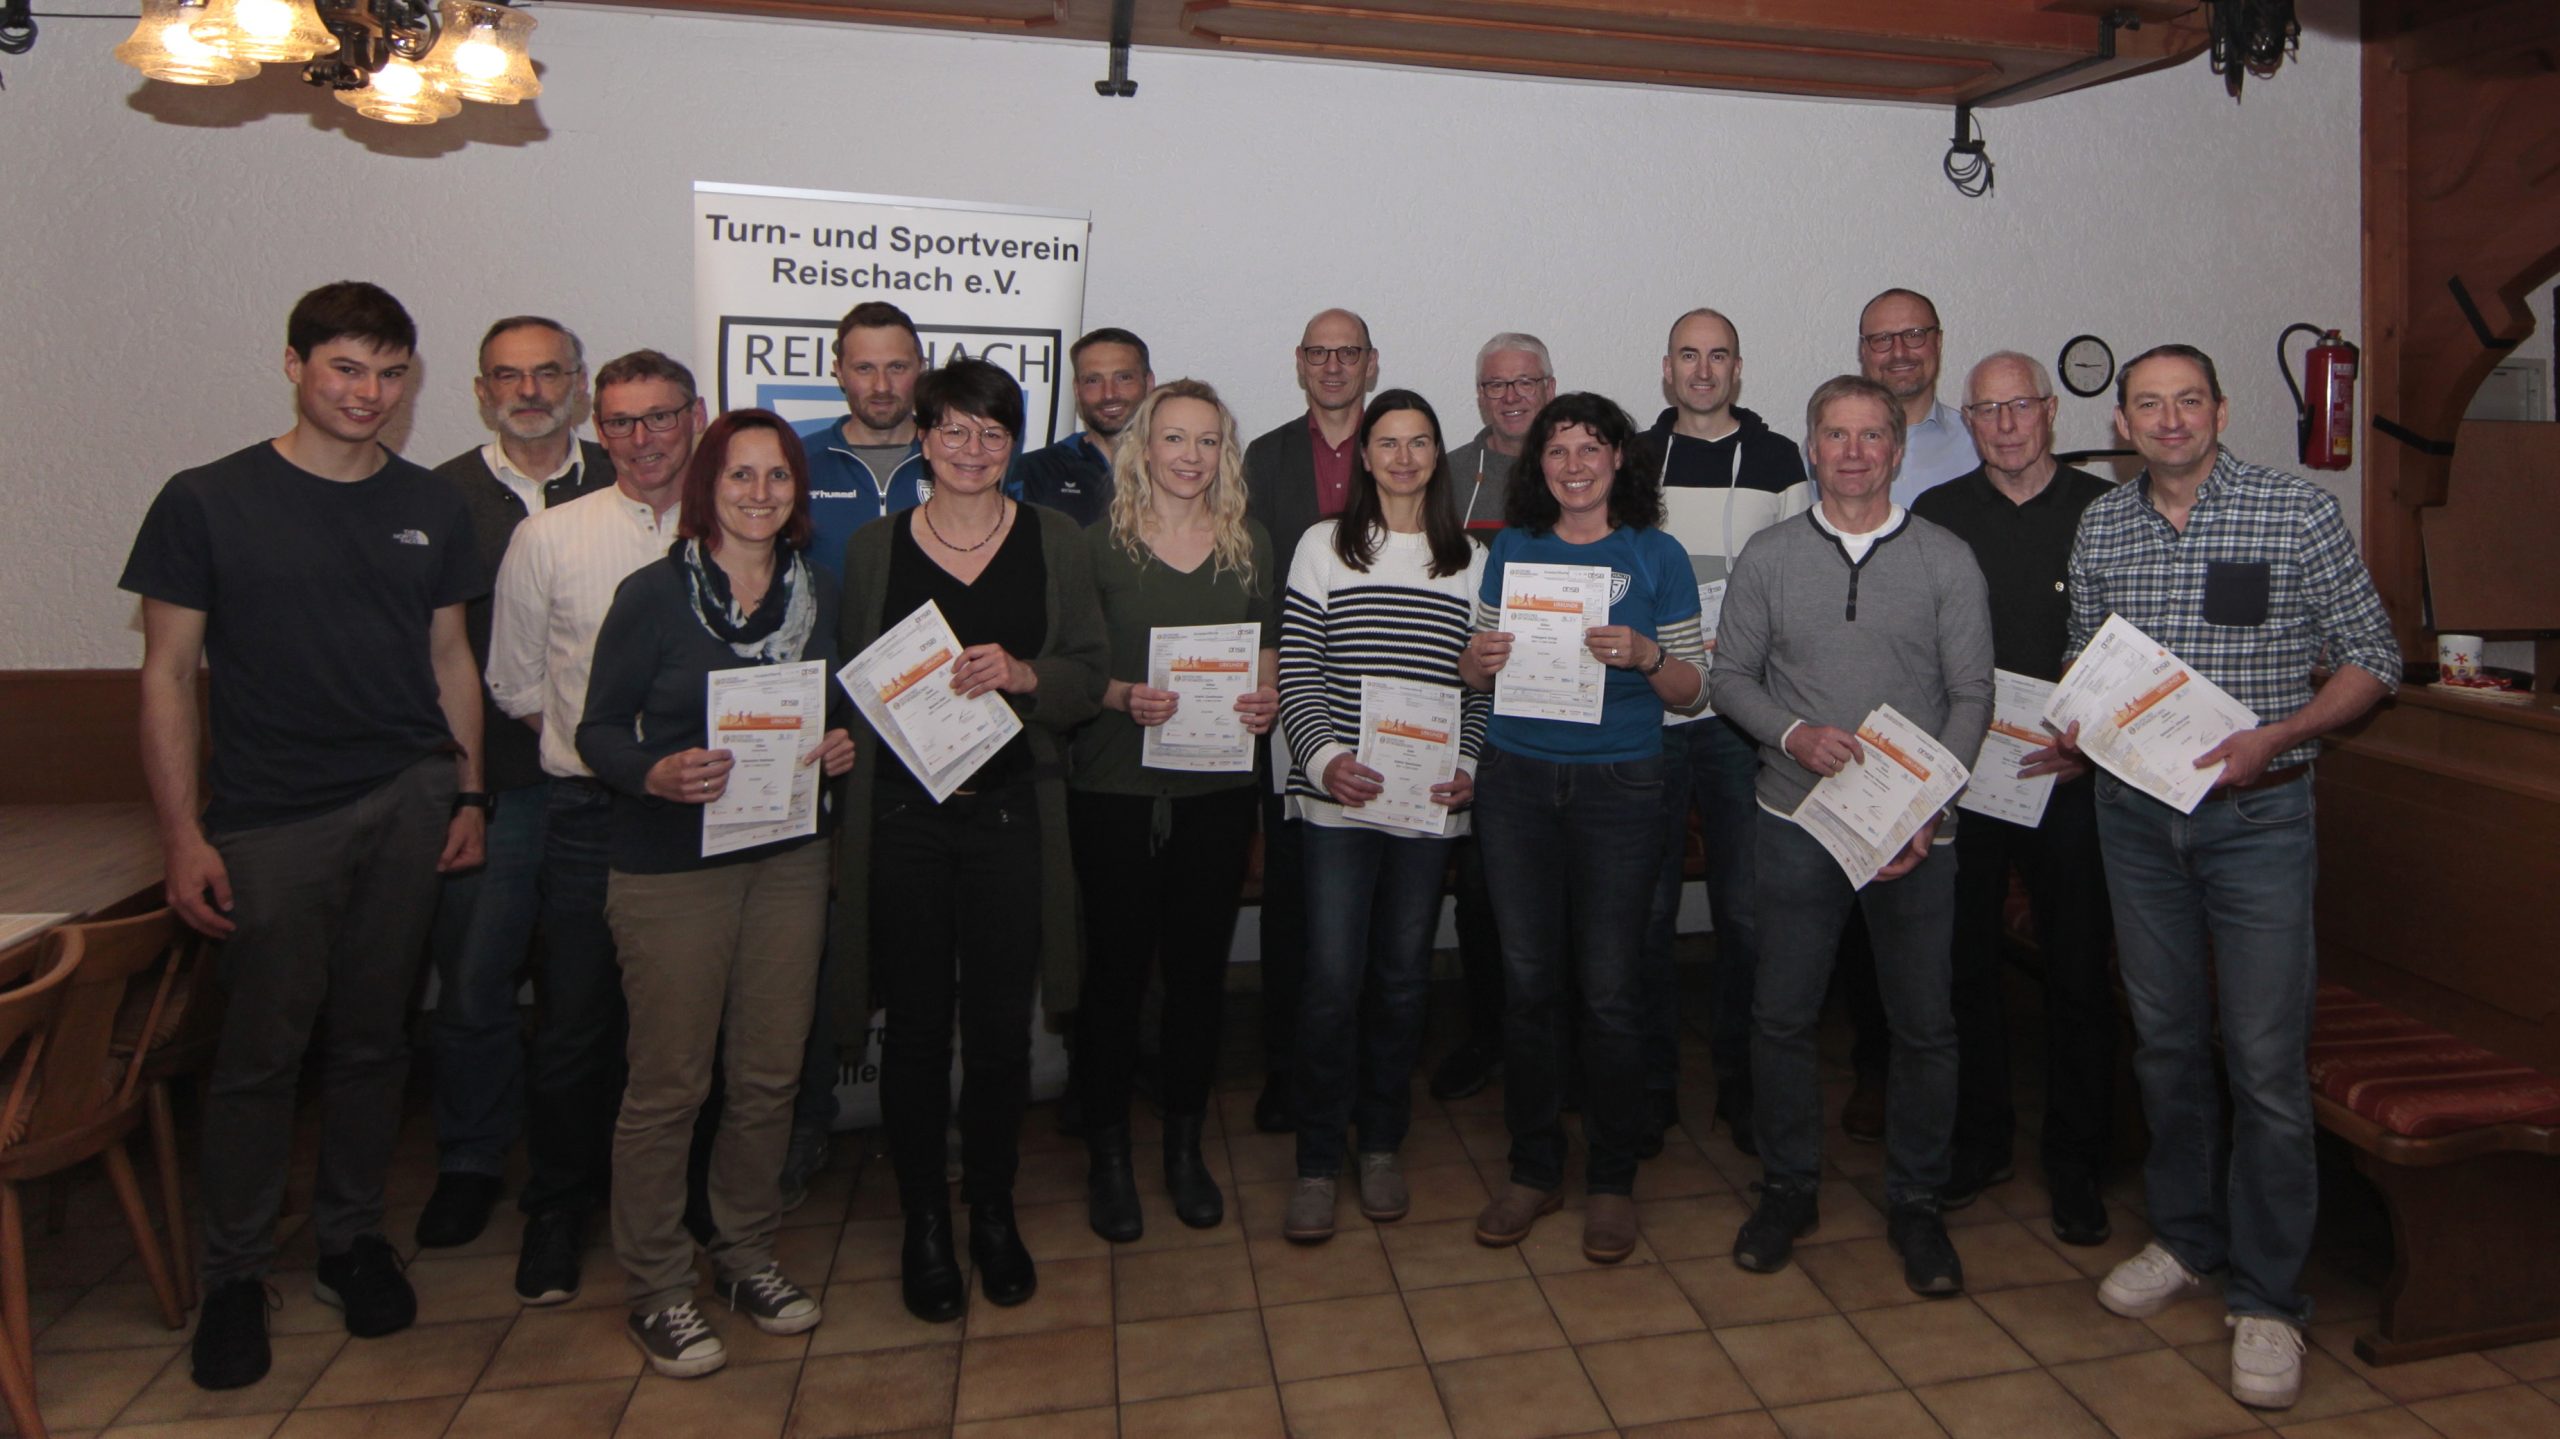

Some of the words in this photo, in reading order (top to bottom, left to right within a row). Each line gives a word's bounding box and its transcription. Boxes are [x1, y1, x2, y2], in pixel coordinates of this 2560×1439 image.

[705, 213, 801, 244] Turn-
[813, 225, 878, 250] und
[889, 226, 1079, 262] Sportverein
[772, 257, 952, 292] Reischach
[964, 270, 1021, 295] e.V.
